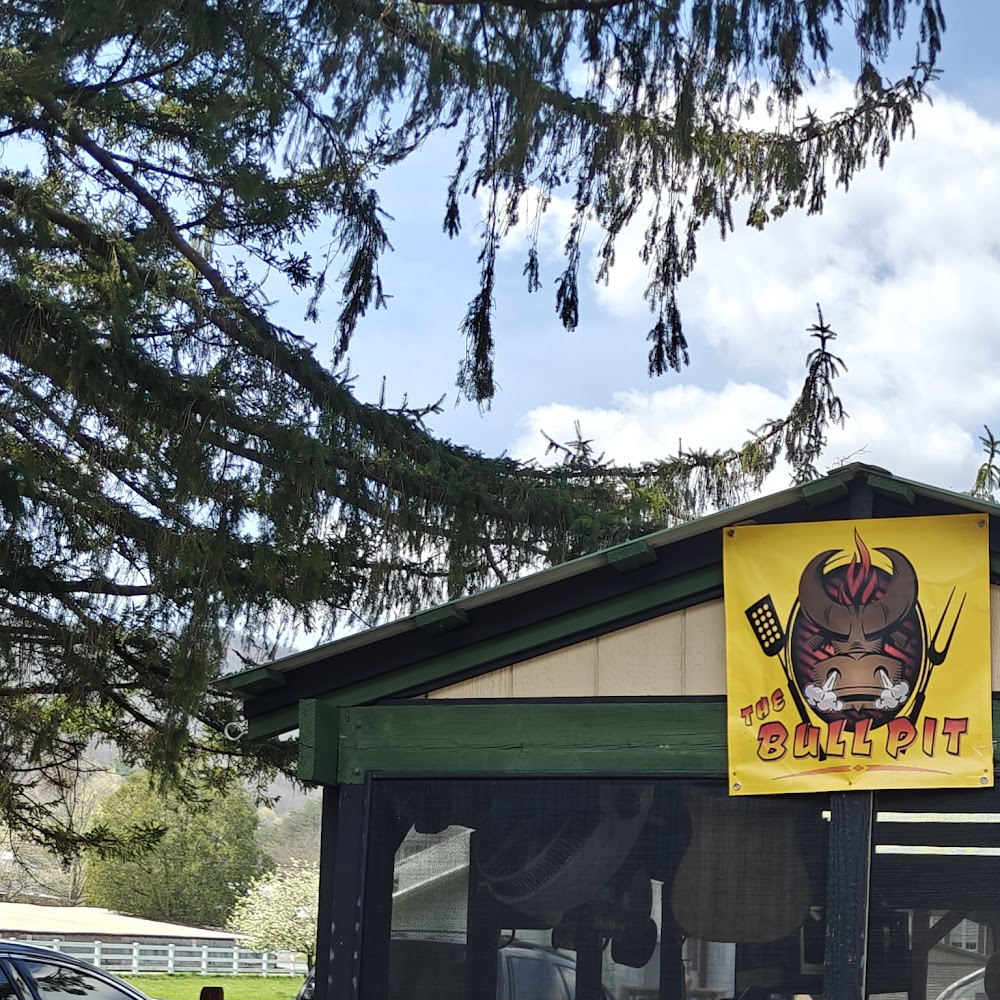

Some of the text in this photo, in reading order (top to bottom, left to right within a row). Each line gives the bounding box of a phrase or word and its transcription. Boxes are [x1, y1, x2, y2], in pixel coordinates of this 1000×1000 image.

[740, 688, 786, 726] THE
[756, 716, 970, 762] BULL PIT
